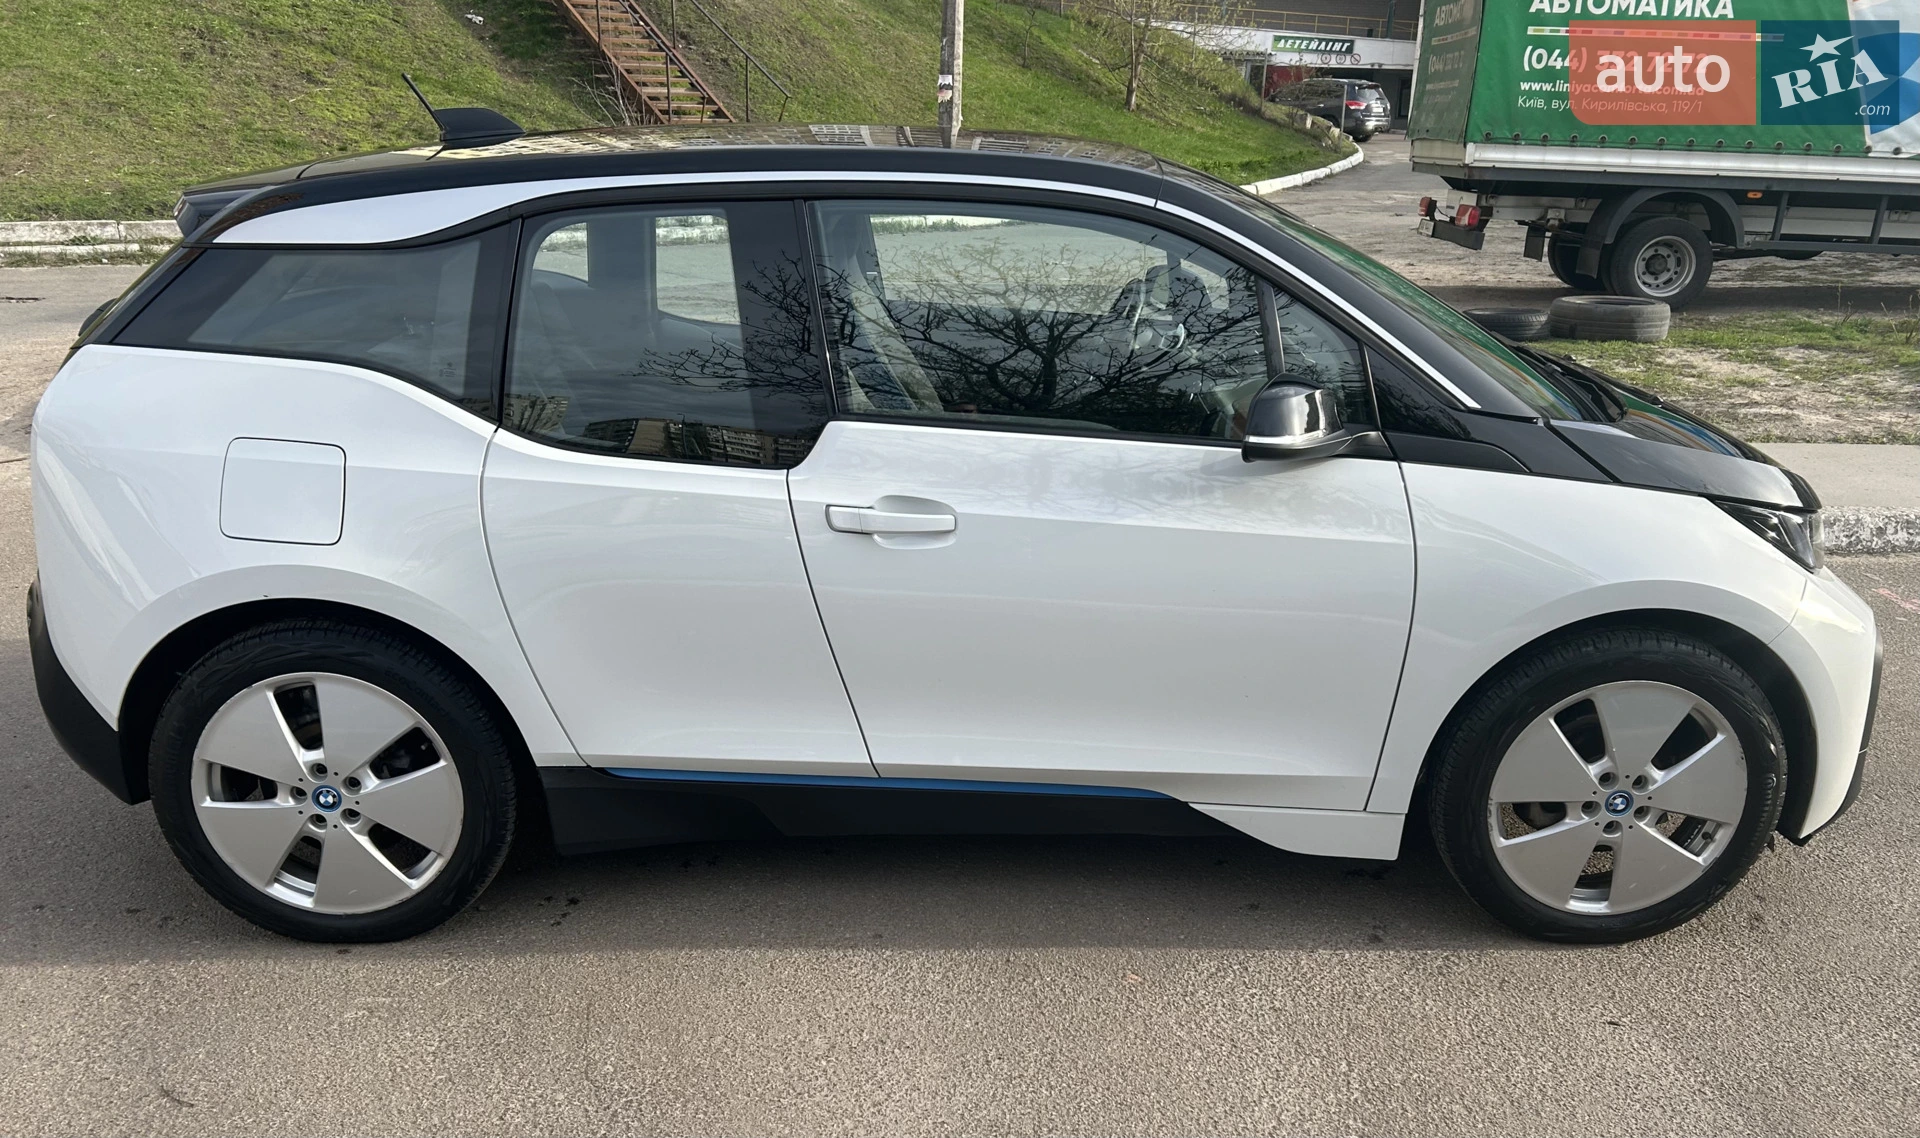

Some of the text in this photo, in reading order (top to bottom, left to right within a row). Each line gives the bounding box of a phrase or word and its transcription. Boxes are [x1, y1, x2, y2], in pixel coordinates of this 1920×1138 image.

[1529, 0, 1734, 18] АВТОМАТИКА
[1277, 39, 1351, 52] ДЕТЕЙЛІНГ
[1523, 46, 1587, 73] (044)
[1518, 96, 1702, 114] Київ, вул. Кирилівська, 119/1
